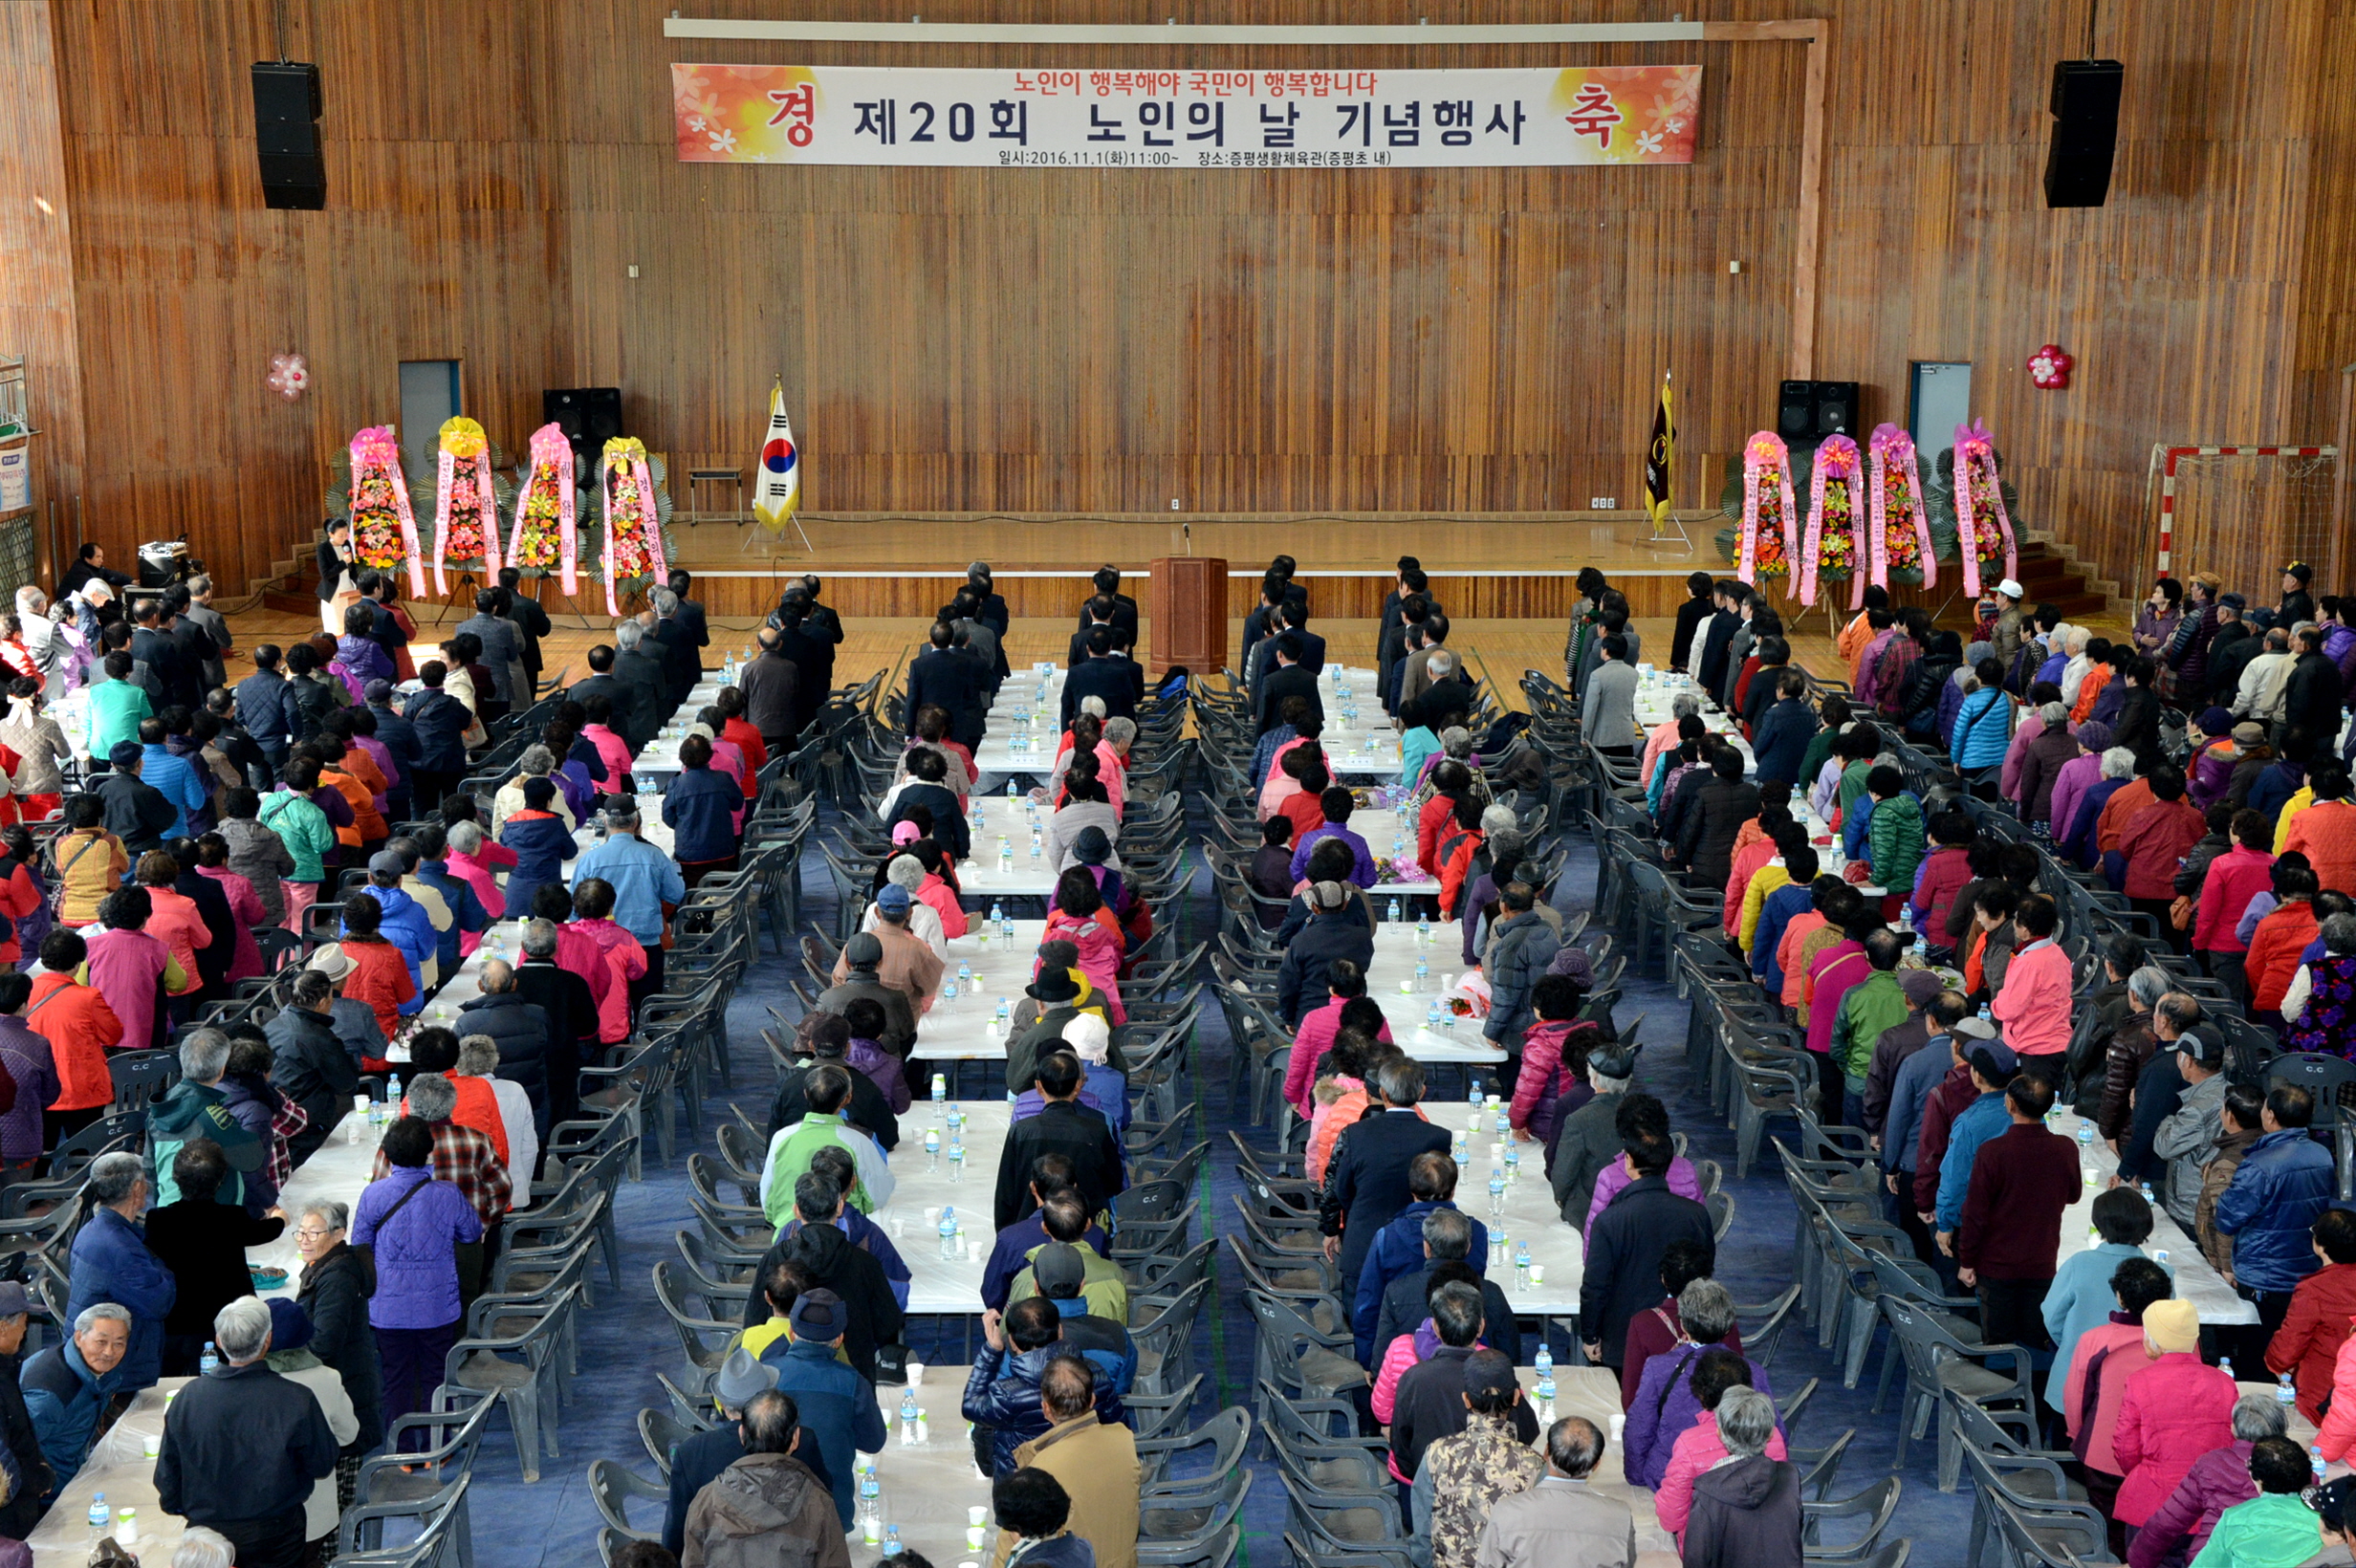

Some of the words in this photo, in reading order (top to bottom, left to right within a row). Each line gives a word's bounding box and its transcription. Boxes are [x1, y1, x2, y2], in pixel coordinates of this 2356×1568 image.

[1014, 72, 1081, 97] 노인이
[1089, 72, 1181, 98] 행복해야
[1189, 72, 1255, 97] 국민이
[1263, 72, 1379, 98] 행복합니다
[769, 84, 814, 147] 경
[853, 98, 1027, 146] 제20회
[1086, 100, 1224, 147] 노인의
[1259, 100, 1300, 148] 날
[1336, 99, 1526, 147] 기념행사
[1565, 86, 1621, 148] 축
[998, 150, 1180, 166] 일시:2016.11.1(화)11:00~
[1198, 151, 1369, 167] 장소:증평생활체육관(증평초
[1374, 151, 1392, 166] 내)
